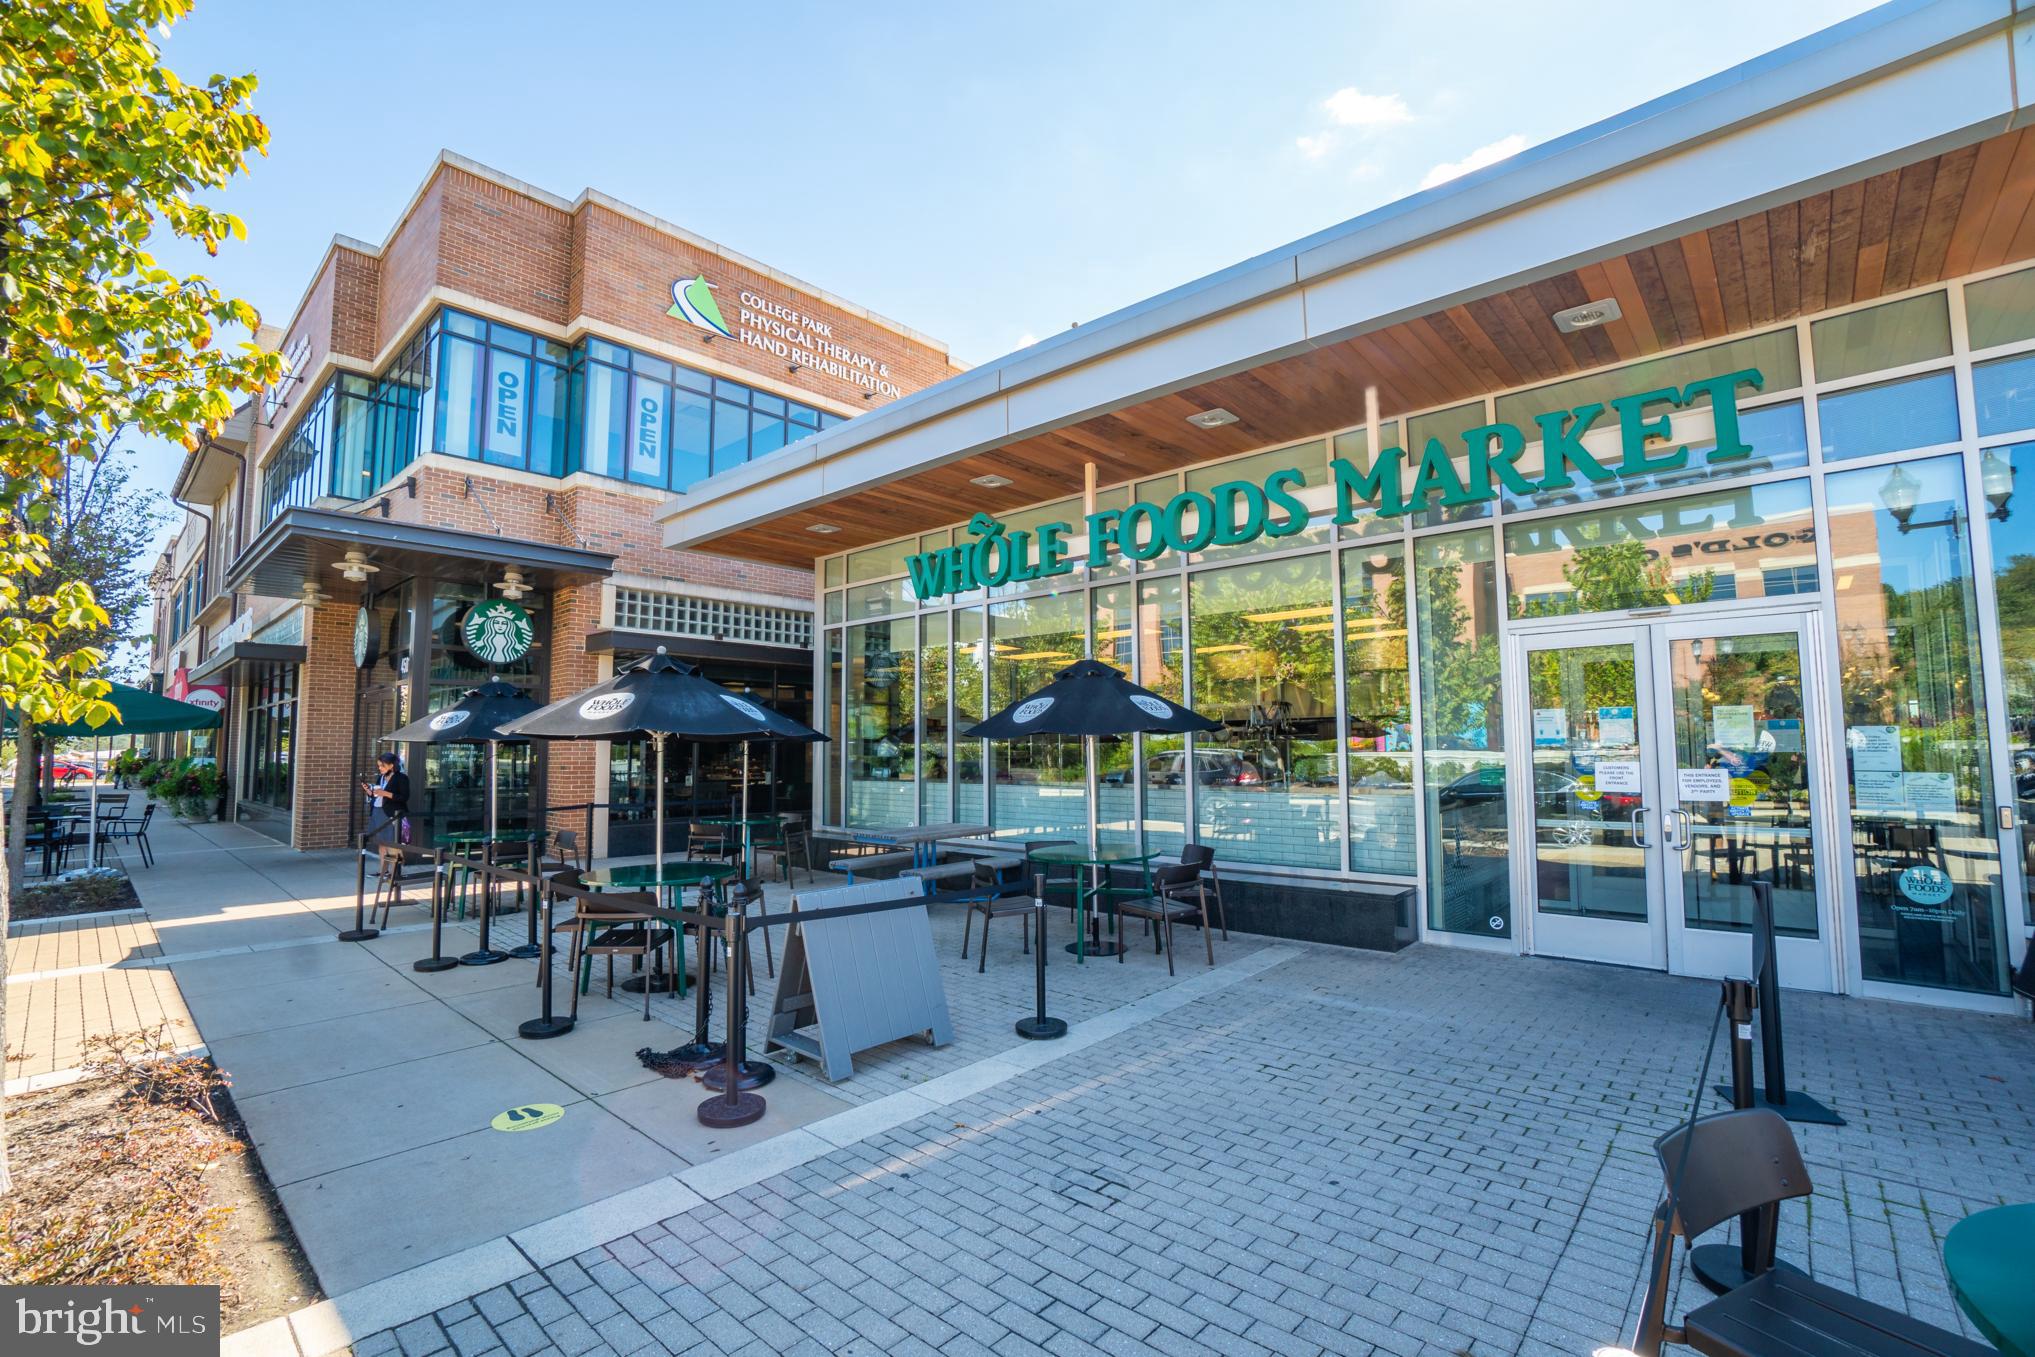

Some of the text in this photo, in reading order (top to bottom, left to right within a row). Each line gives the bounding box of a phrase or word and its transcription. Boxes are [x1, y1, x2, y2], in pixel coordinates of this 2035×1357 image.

[740, 291, 832, 338] COLLEGE PARK
[740, 308, 890, 378] PHYSICAL THERAPY &
[739, 328, 901, 399] HAND REHABILITATION
[496, 371, 519, 438] OPEN
[639, 397, 658, 459] OPEN
[904, 367, 1764, 599] WHOLE FOODS MARKET
[1890, 904, 1909, 912] Open
[1908, 884, 1947, 894] FOODS
